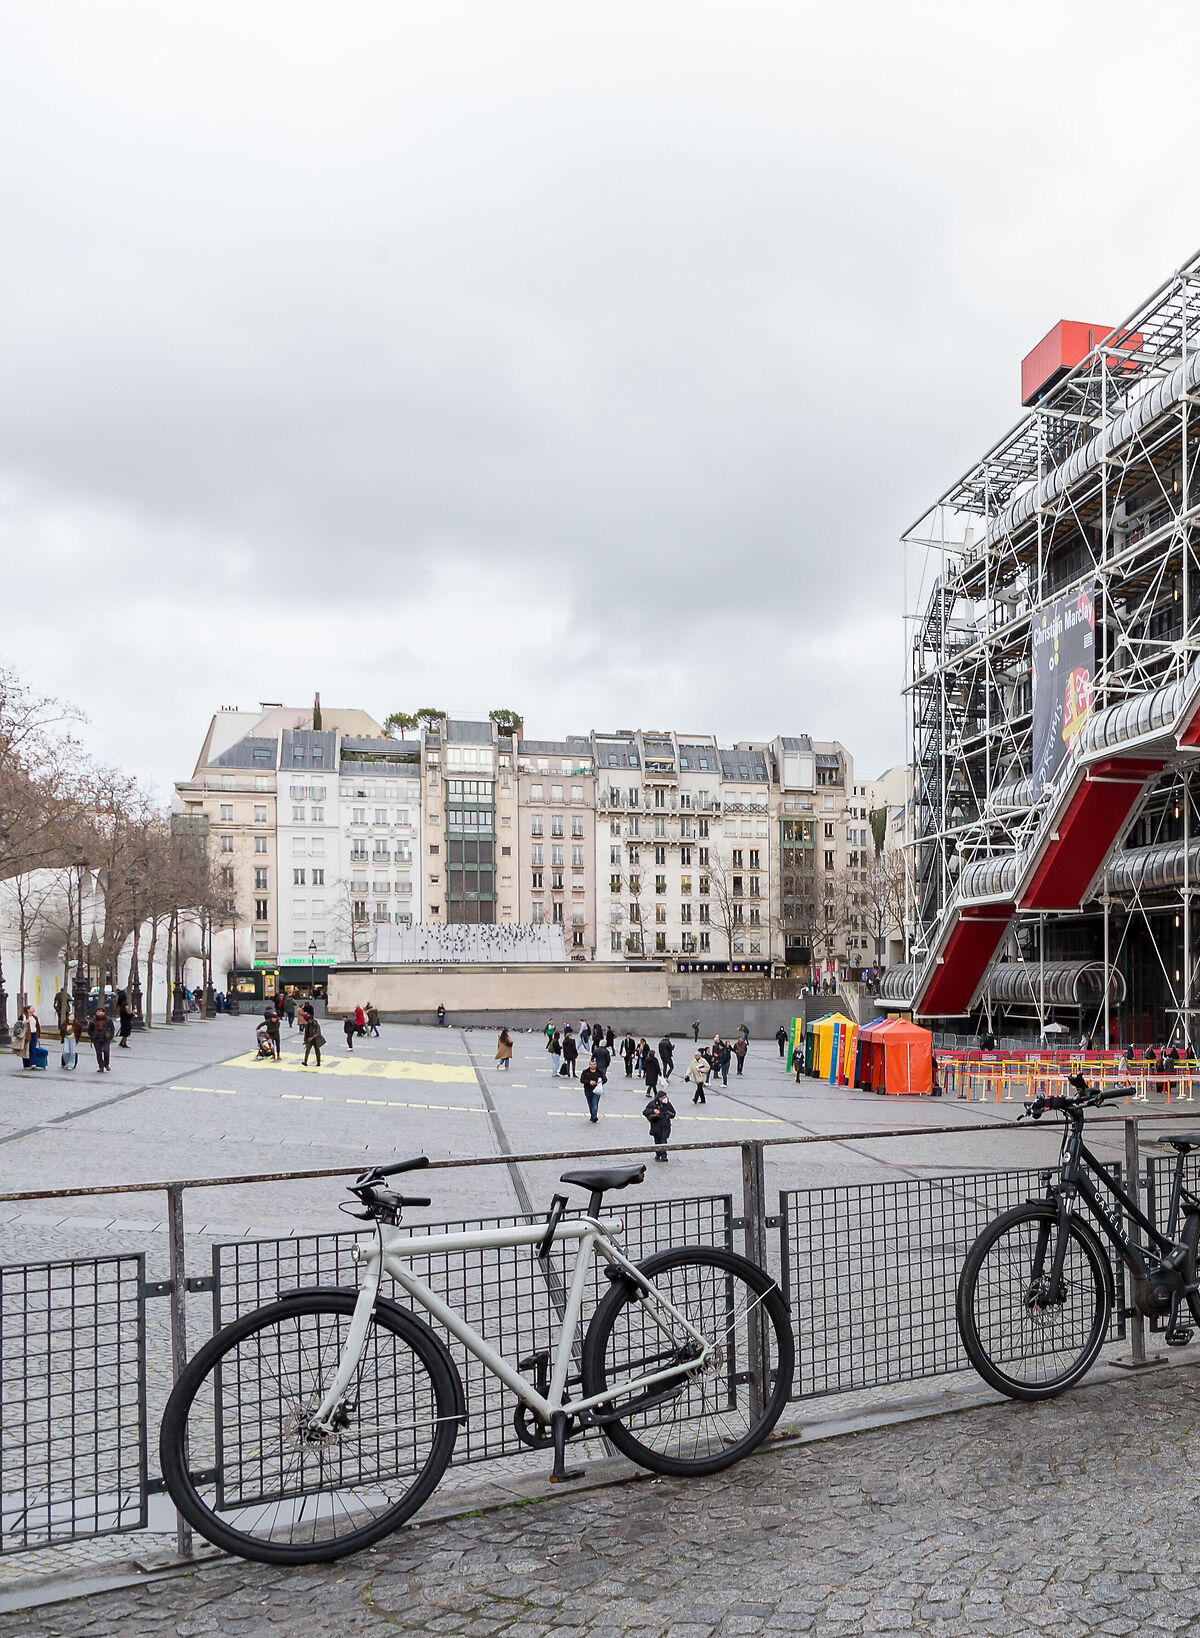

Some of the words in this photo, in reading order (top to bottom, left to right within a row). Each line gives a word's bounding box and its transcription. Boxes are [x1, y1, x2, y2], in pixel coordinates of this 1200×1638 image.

[1034, 614, 1063, 647] Christian
[1064, 601, 1093, 631] Marclay
[1095, 1192, 1129, 1245] GAZELLE
